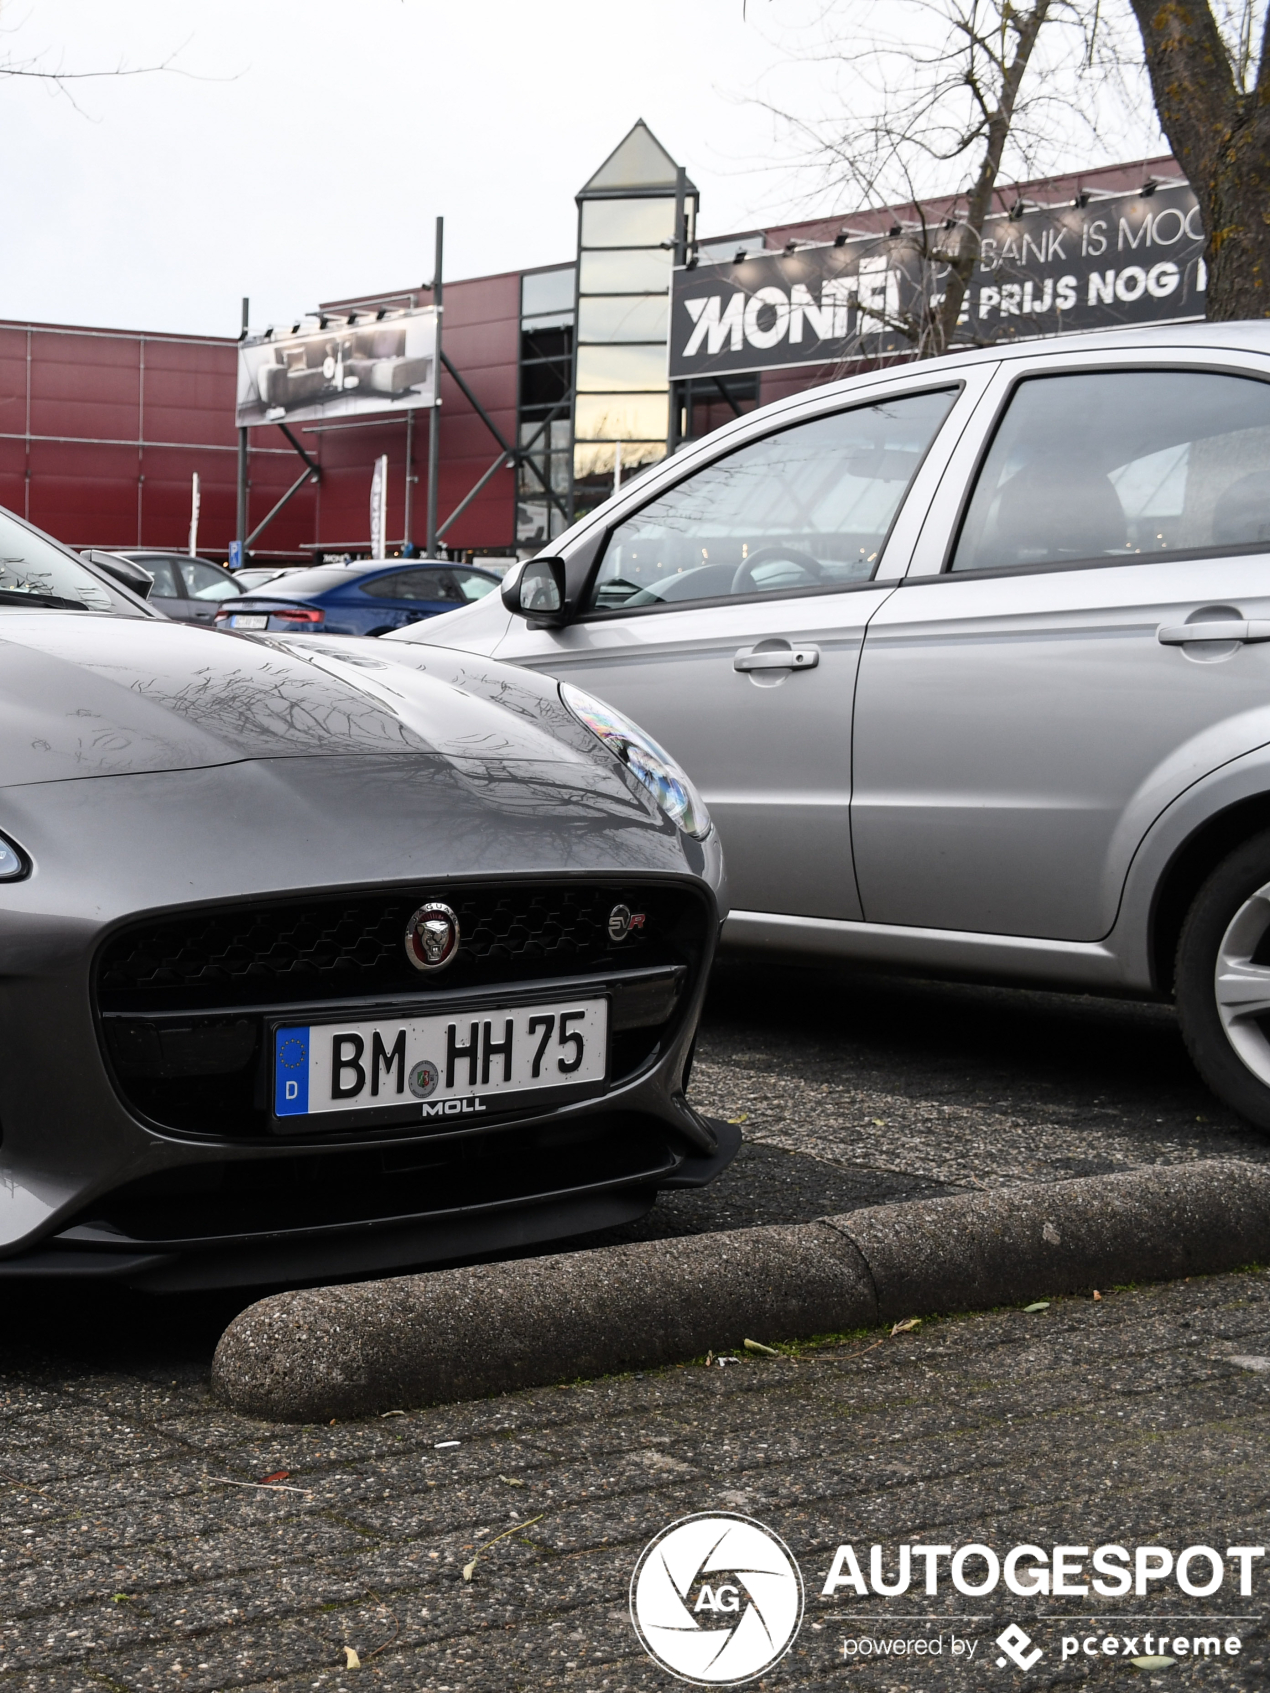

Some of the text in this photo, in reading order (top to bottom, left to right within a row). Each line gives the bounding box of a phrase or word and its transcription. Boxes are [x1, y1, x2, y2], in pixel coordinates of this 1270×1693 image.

[980, 228, 1068, 273] BANK
[1081, 220, 1108, 257] IS
[978, 275, 1078, 320] PRIJS
[1087, 261, 1180, 306] NOG
[608, 913, 646, 931] SVR
[285, 1080, 298, 1100] D
[331, 1027, 407, 1100] BM
[445, 1017, 514, 1089] HH
[528, 1008, 586, 1079] 75
[421, 1097, 487, 1117] MOLL
